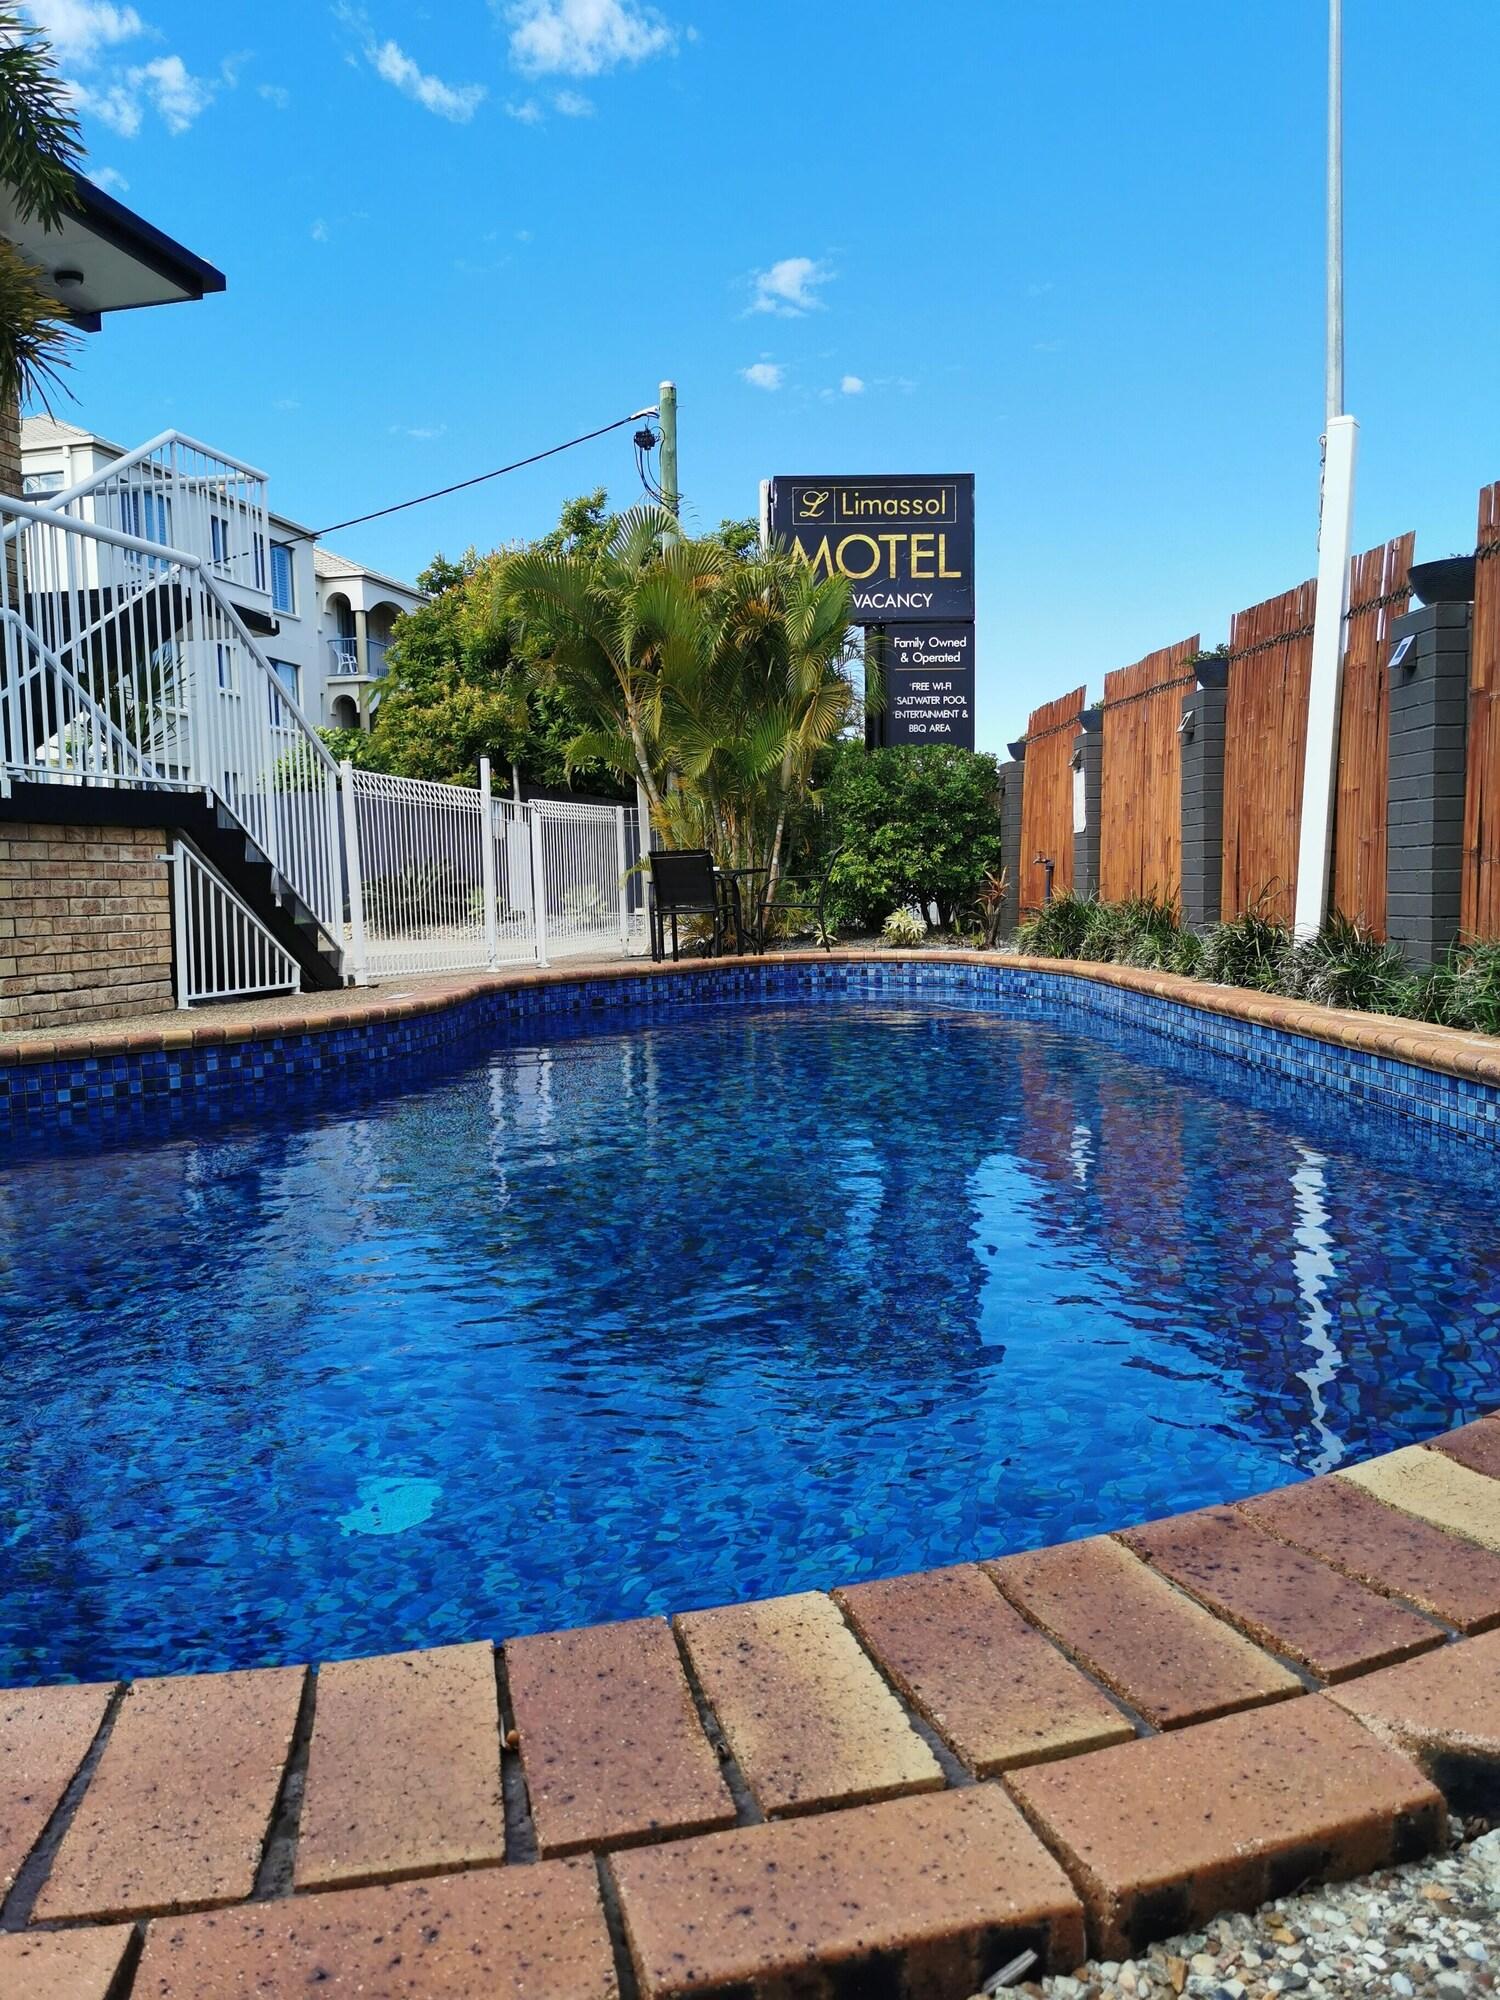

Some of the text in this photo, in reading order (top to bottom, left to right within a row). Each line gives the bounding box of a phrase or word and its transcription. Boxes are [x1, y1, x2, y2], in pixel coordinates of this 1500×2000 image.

[842, 489, 946, 516] Limassol
[790, 533, 962, 580] MOTEL
[852, 592, 933, 609] VACANCY
[894, 636, 967, 650] Family Owned
[900, 651, 961, 665] & Operated
[932, 682, 952, 691] WI-FI
[943, 695, 967, 705] POOL
[961, 709, 969, 719] &
[908, 724, 951, 733] BBQ AREA
